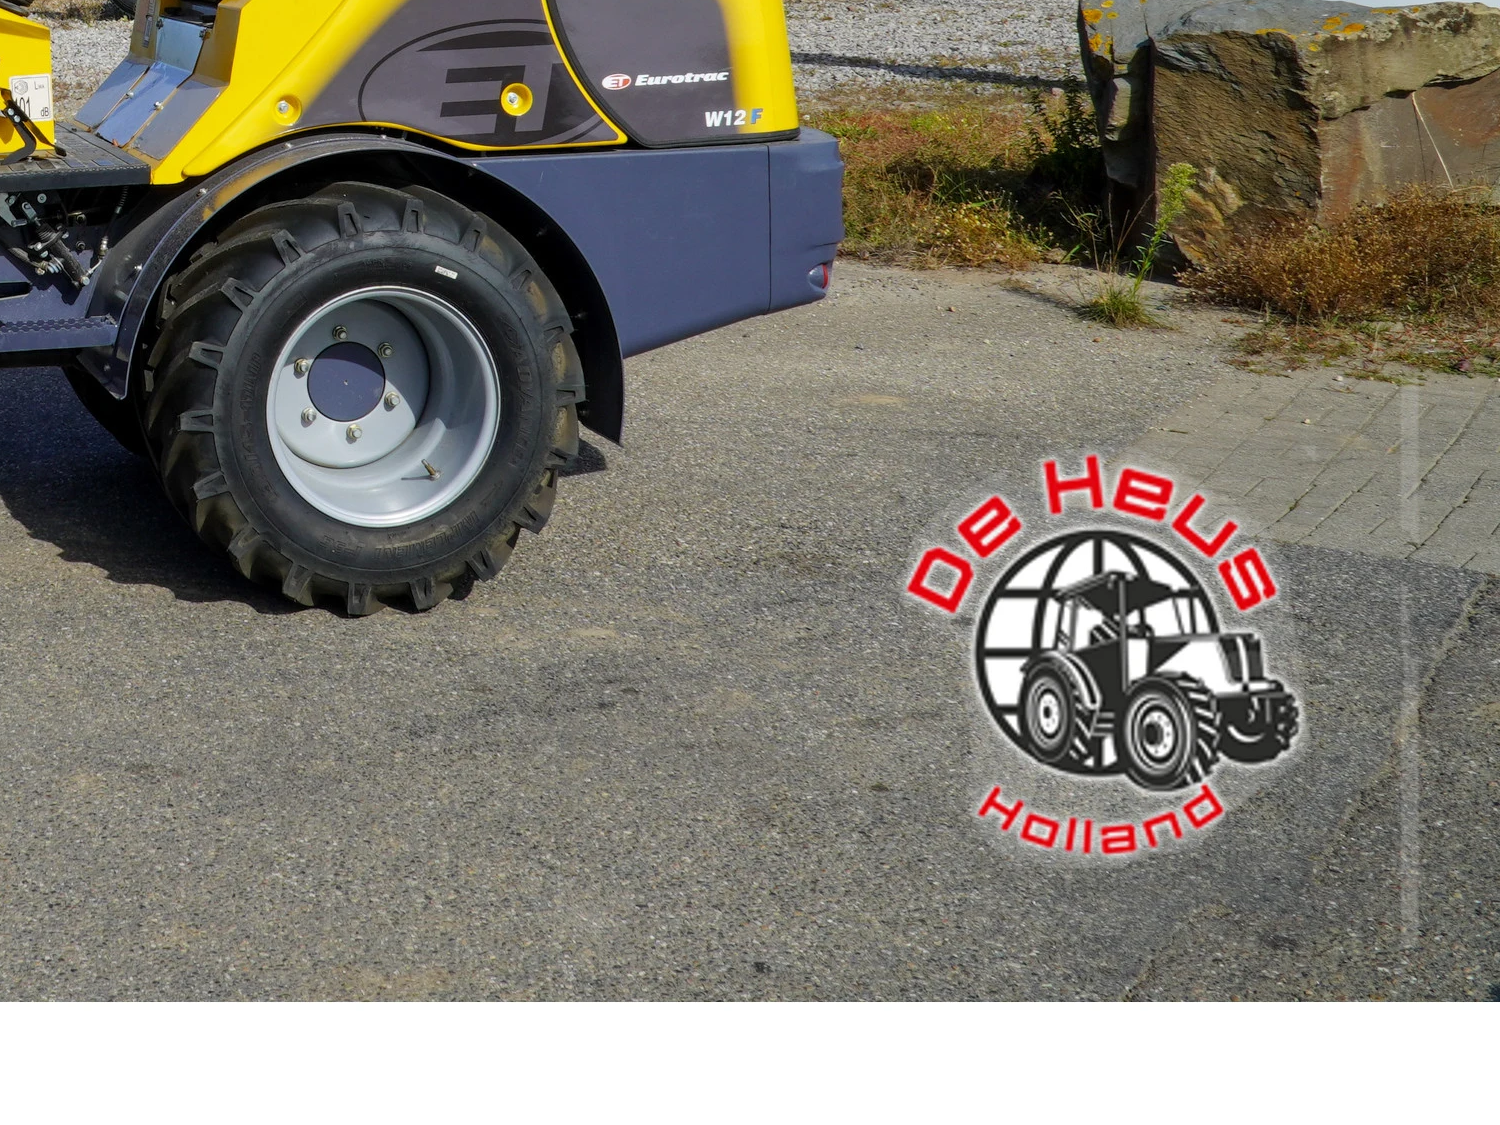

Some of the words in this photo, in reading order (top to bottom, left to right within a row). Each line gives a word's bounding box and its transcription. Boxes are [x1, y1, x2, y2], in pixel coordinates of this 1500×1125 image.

[634, 72, 729, 86] Eurotrac
[40, 106, 50, 117] dB
[705, 109, 746, 127] W12
[750, 108, 763, 124] F
